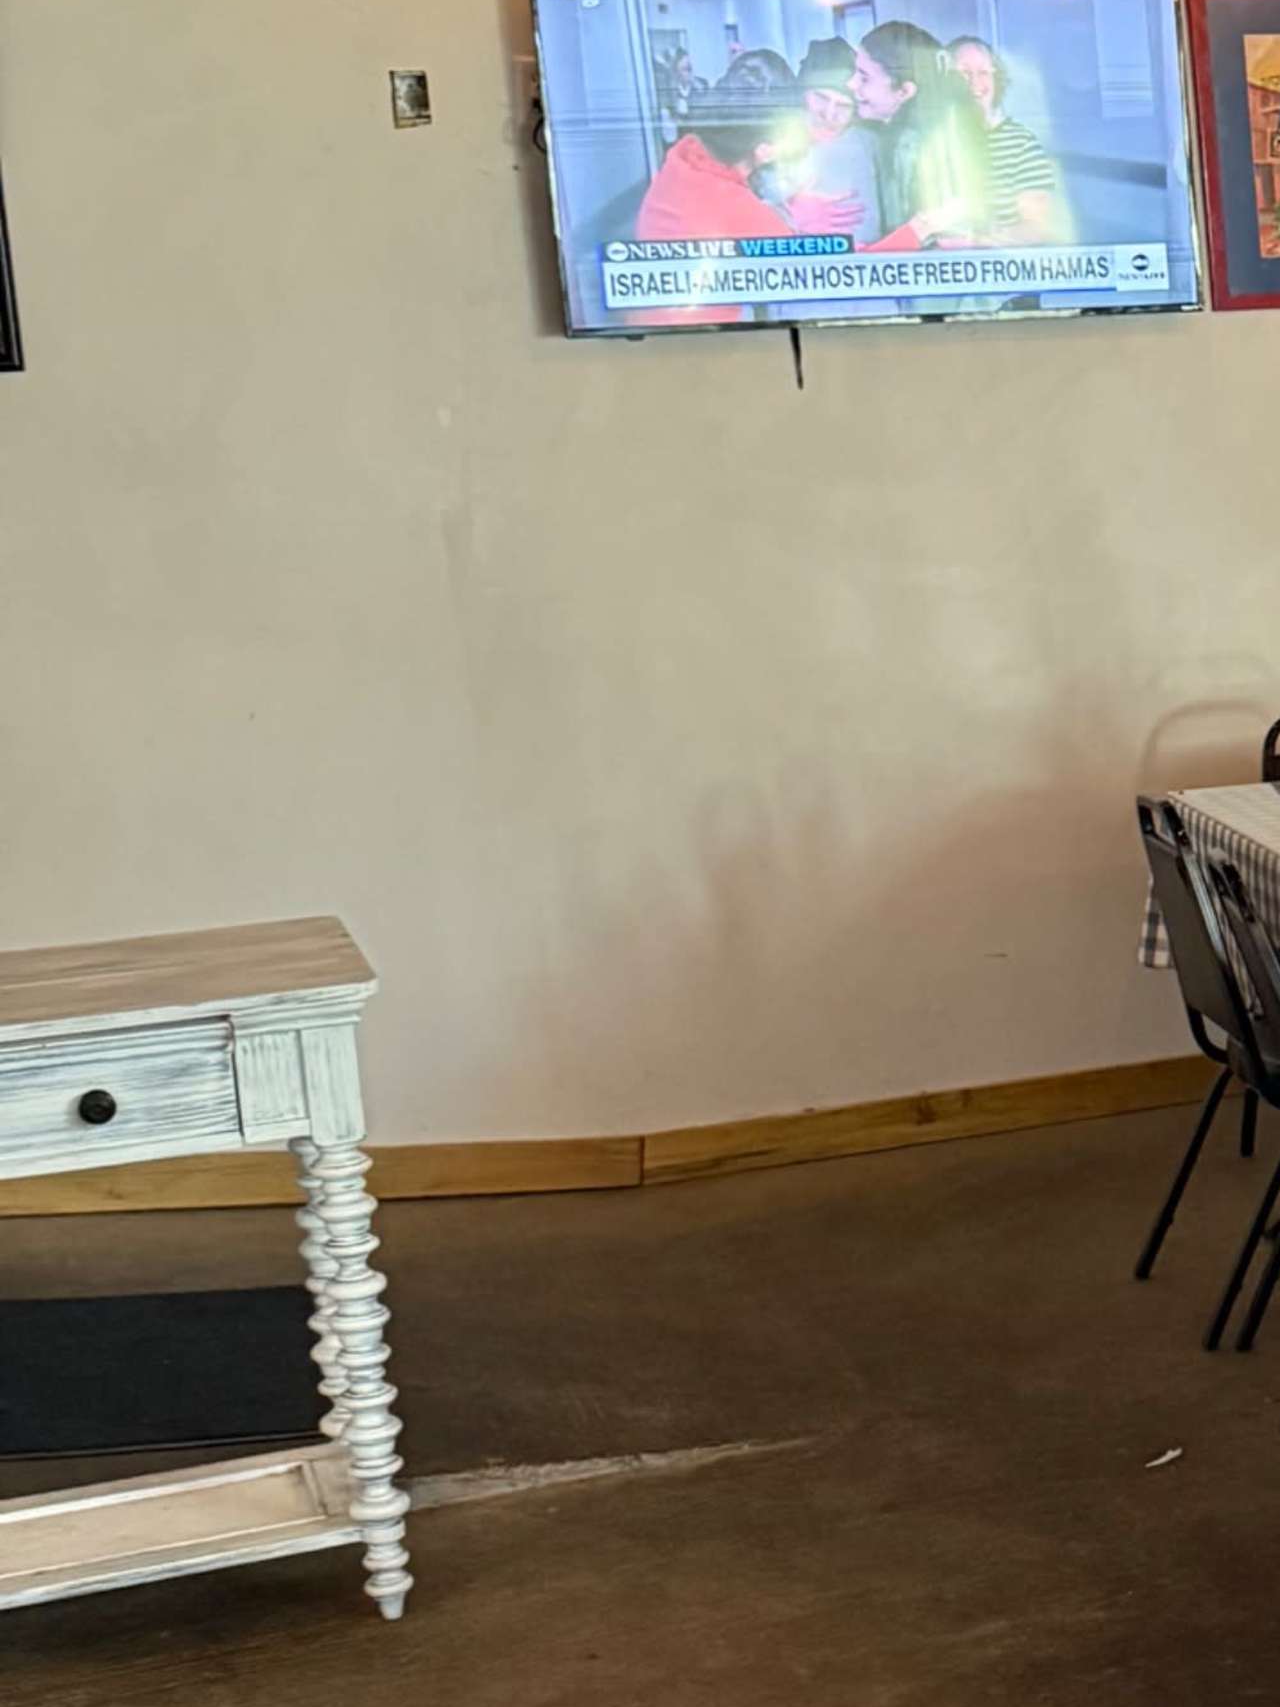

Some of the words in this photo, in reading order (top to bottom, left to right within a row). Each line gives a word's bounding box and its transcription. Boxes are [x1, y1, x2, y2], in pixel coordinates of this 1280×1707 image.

[740, 237, 848, 256] WEEKEND
[609, 268, 807, 297] ISRAELI-AMERICAN
[812, 262, 909, 290] HOSTAGE
[913, 260, 977, 286] FREED
[981, 257, 1036, 283] FROM
[1041, 255, 1110, 281] HAMAS
